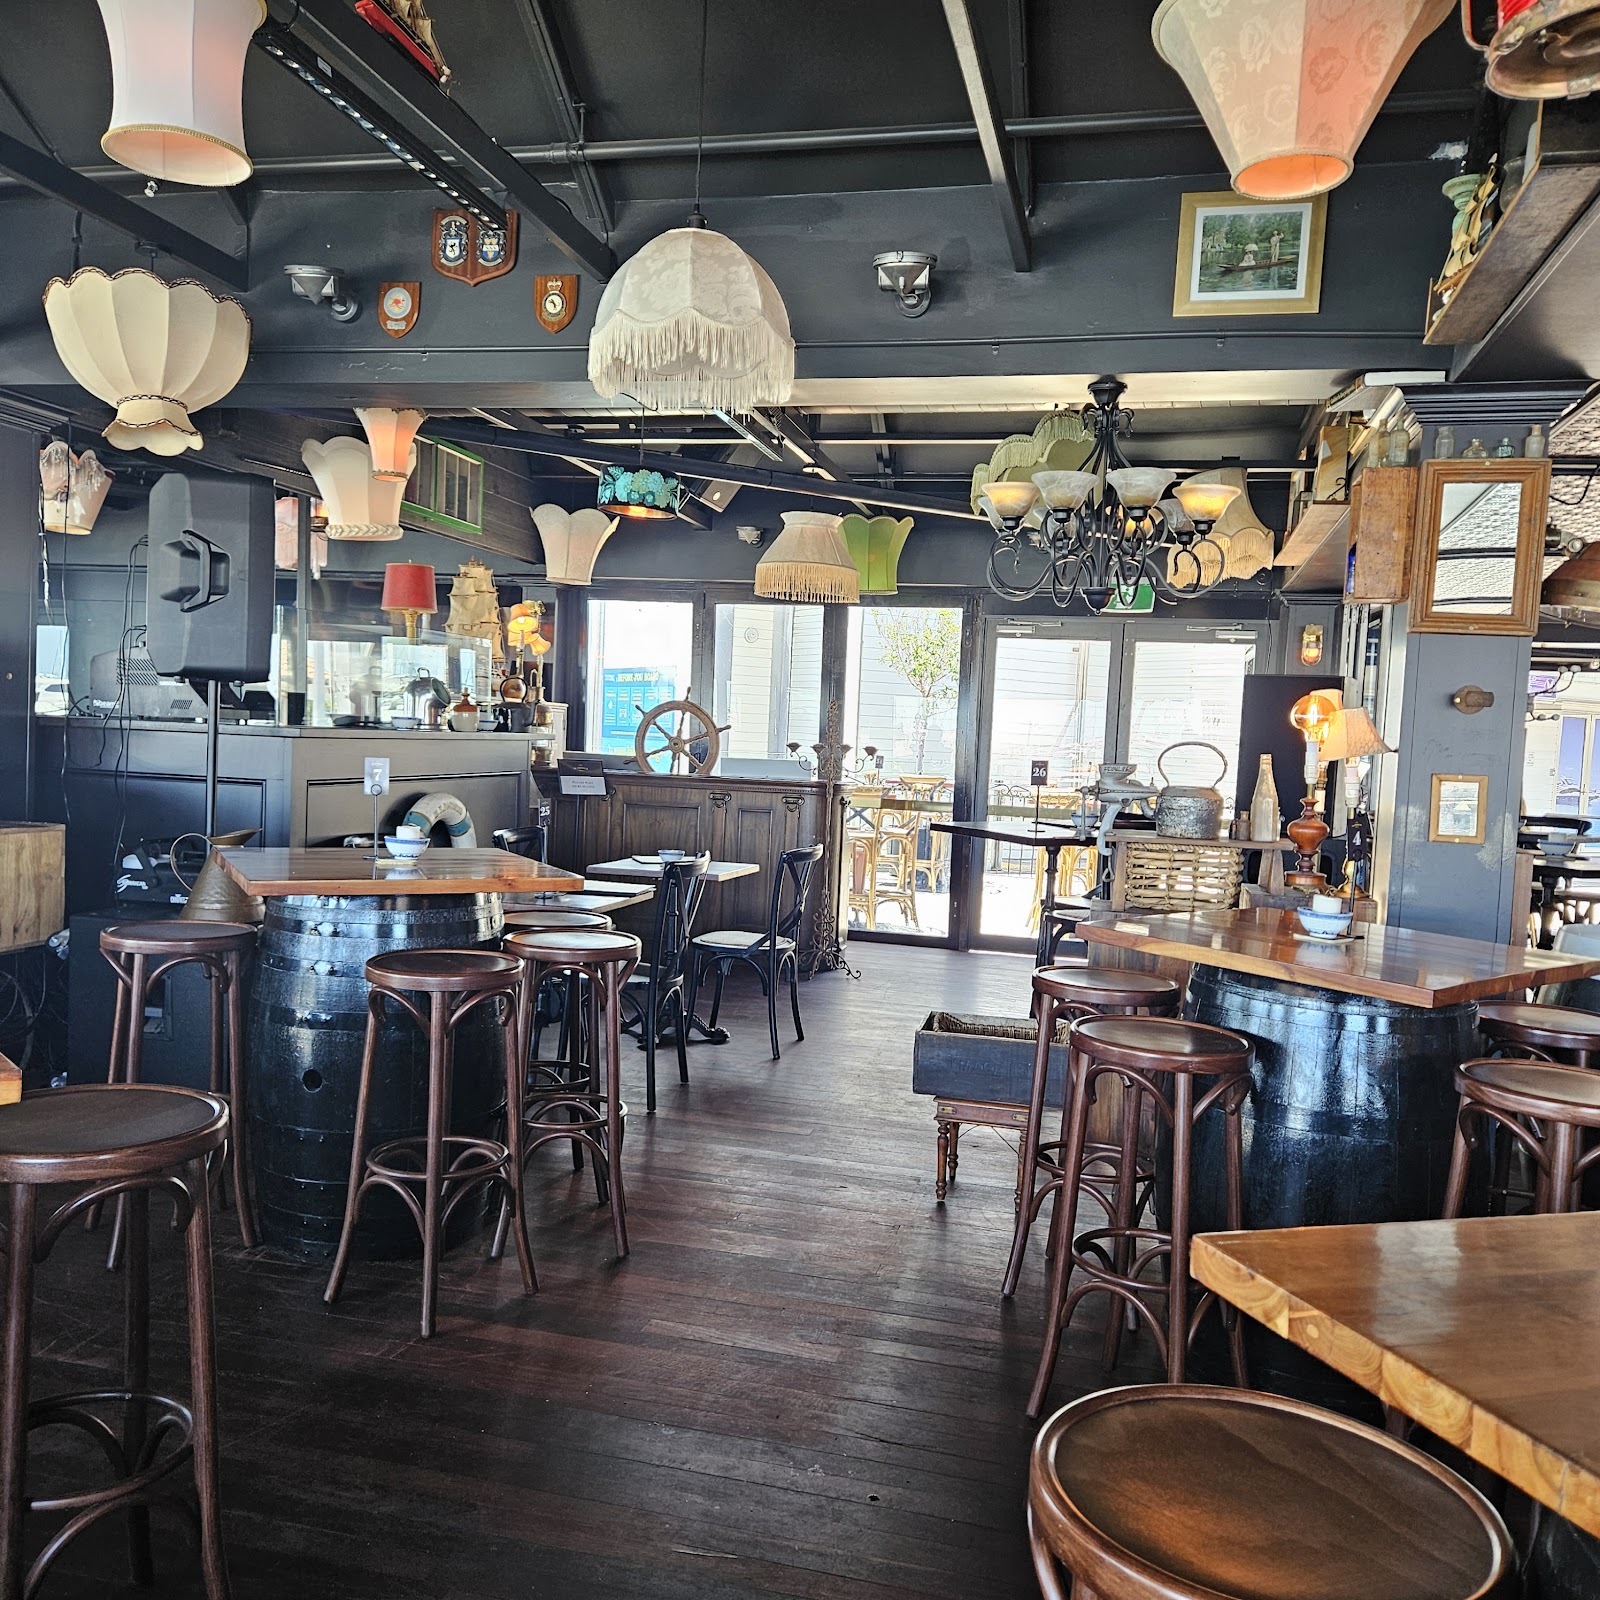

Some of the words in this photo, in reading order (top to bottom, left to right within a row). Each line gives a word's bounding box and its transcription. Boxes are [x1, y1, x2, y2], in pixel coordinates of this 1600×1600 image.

[373, 768, 383, 781] 7
[1032, 767, 1046, 777] 26
[540, 806, 550, 816] 25
[1352, 830, 1361, 846] 4
